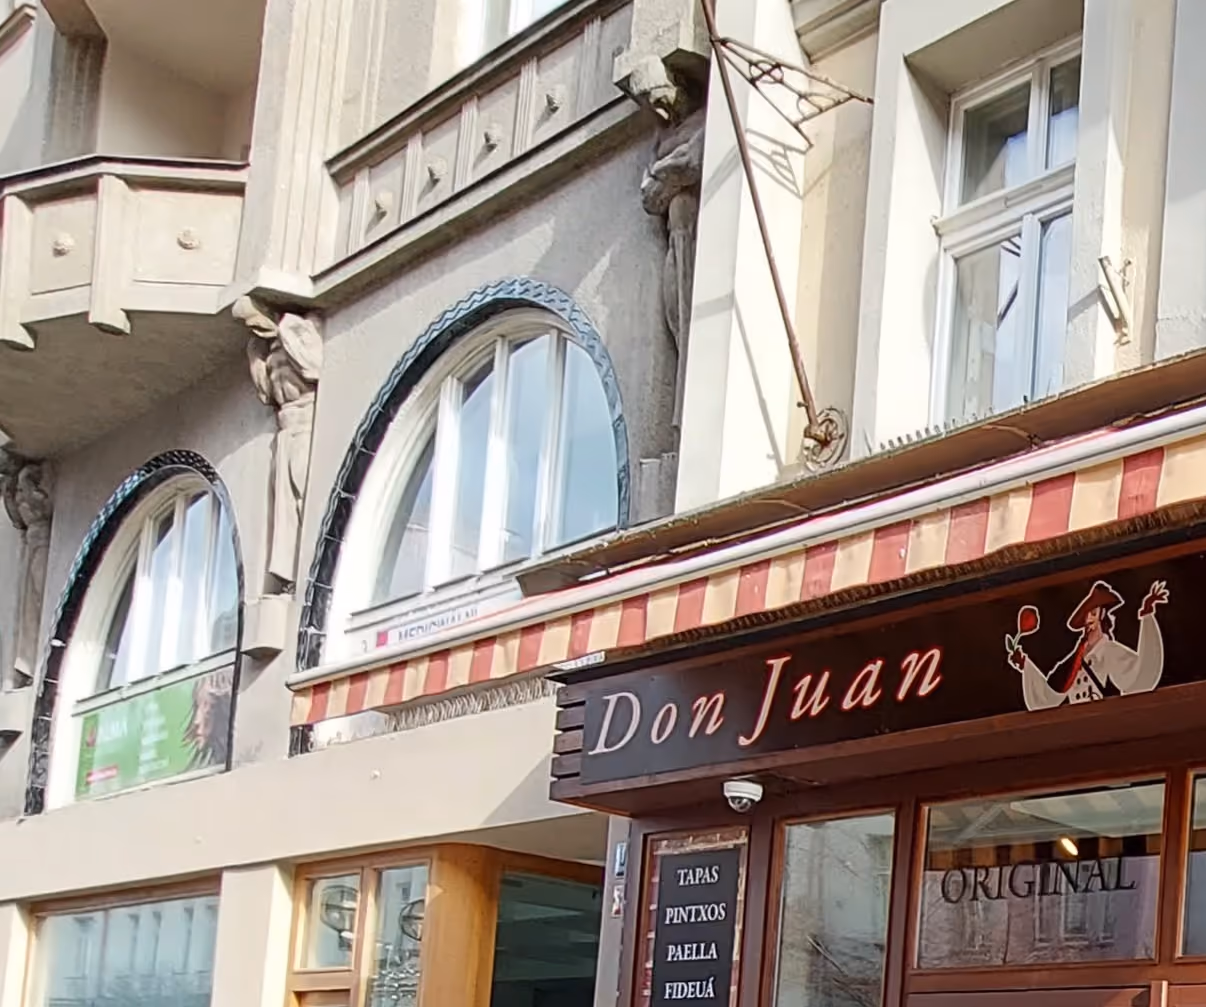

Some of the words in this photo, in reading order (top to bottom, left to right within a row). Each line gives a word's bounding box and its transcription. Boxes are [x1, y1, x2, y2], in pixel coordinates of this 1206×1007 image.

[588, 691, 725, 756] Don
[738, 646, 944, 747] Juan
[677, 866, 719, 886] TAPAS
[941, 857, 1137, 904] ORIGINAL
[664, 902, 727, 925] PINTXOS
[666, 943, 718, 961] PAELLA
[664, 977, 715, 999] FIDEUÁ
